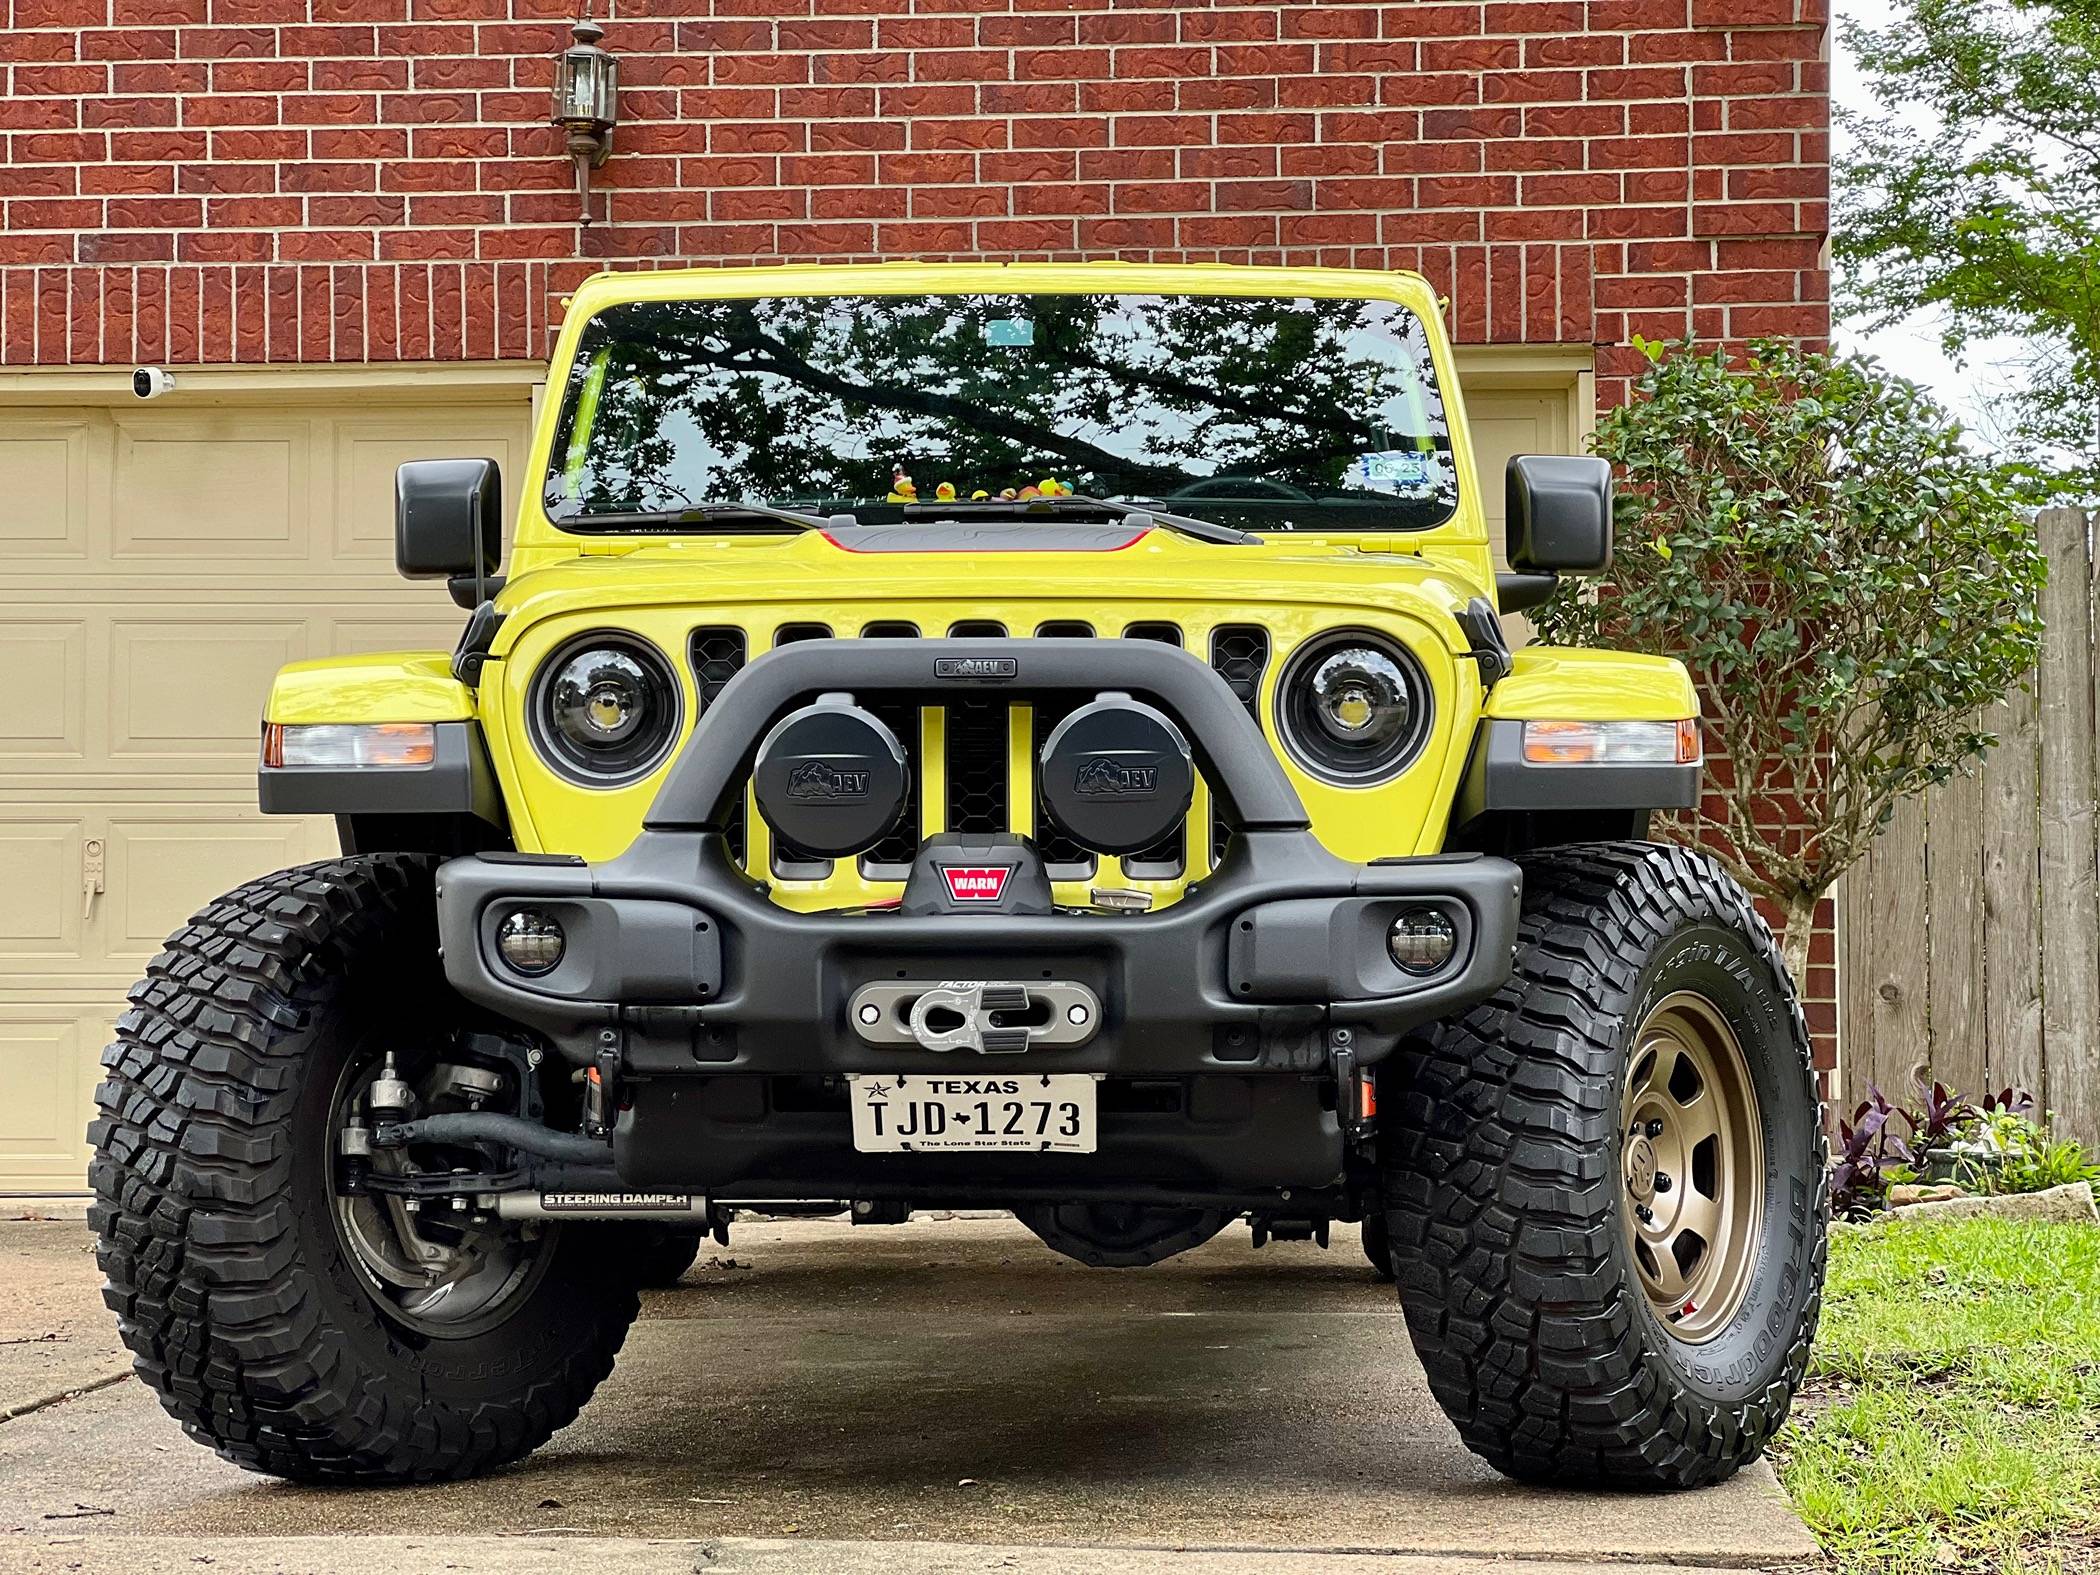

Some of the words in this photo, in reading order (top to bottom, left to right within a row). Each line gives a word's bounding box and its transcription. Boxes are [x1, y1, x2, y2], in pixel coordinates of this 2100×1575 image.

[974, 661, 998, 674] AEV
[833, 774, 867, 793] AEV
[1120, 769, 1154, 788] AEV
[953, 877, 999, 890] WARN
[926, 1080, 1020, 1095] TEXAS
[866, 1101, 946, 1136] TJD
[973, 1101, 1081, 1137] 1273
[544, 1194, 621, 1204] STEERING
[622, 1194, 687, 1204] DAMPER
